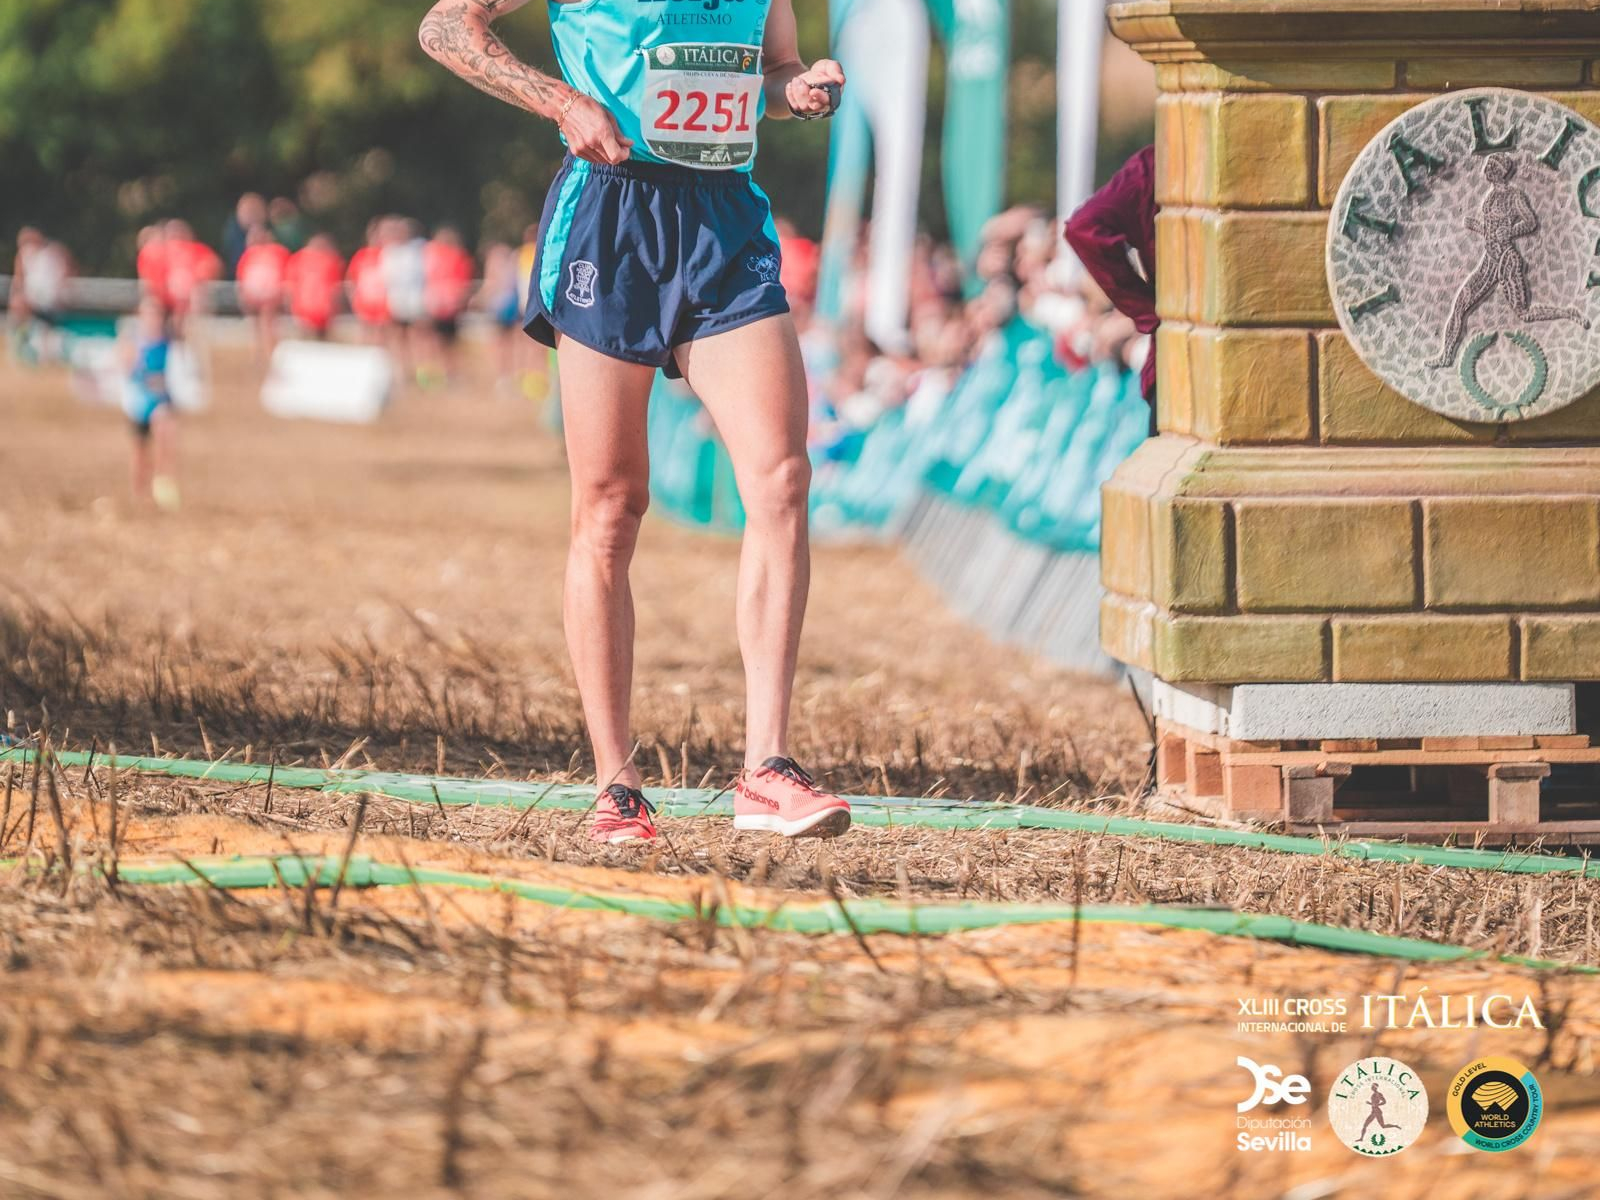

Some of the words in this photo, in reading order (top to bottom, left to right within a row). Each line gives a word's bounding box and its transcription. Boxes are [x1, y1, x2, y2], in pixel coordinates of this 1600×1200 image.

[656, 13, 733, 26] ATLETISMO
[683, 46, 739, 65] ITÁLICA
[653, 89, 750, 134] 2251
[744, 786, 780, 811] balance
